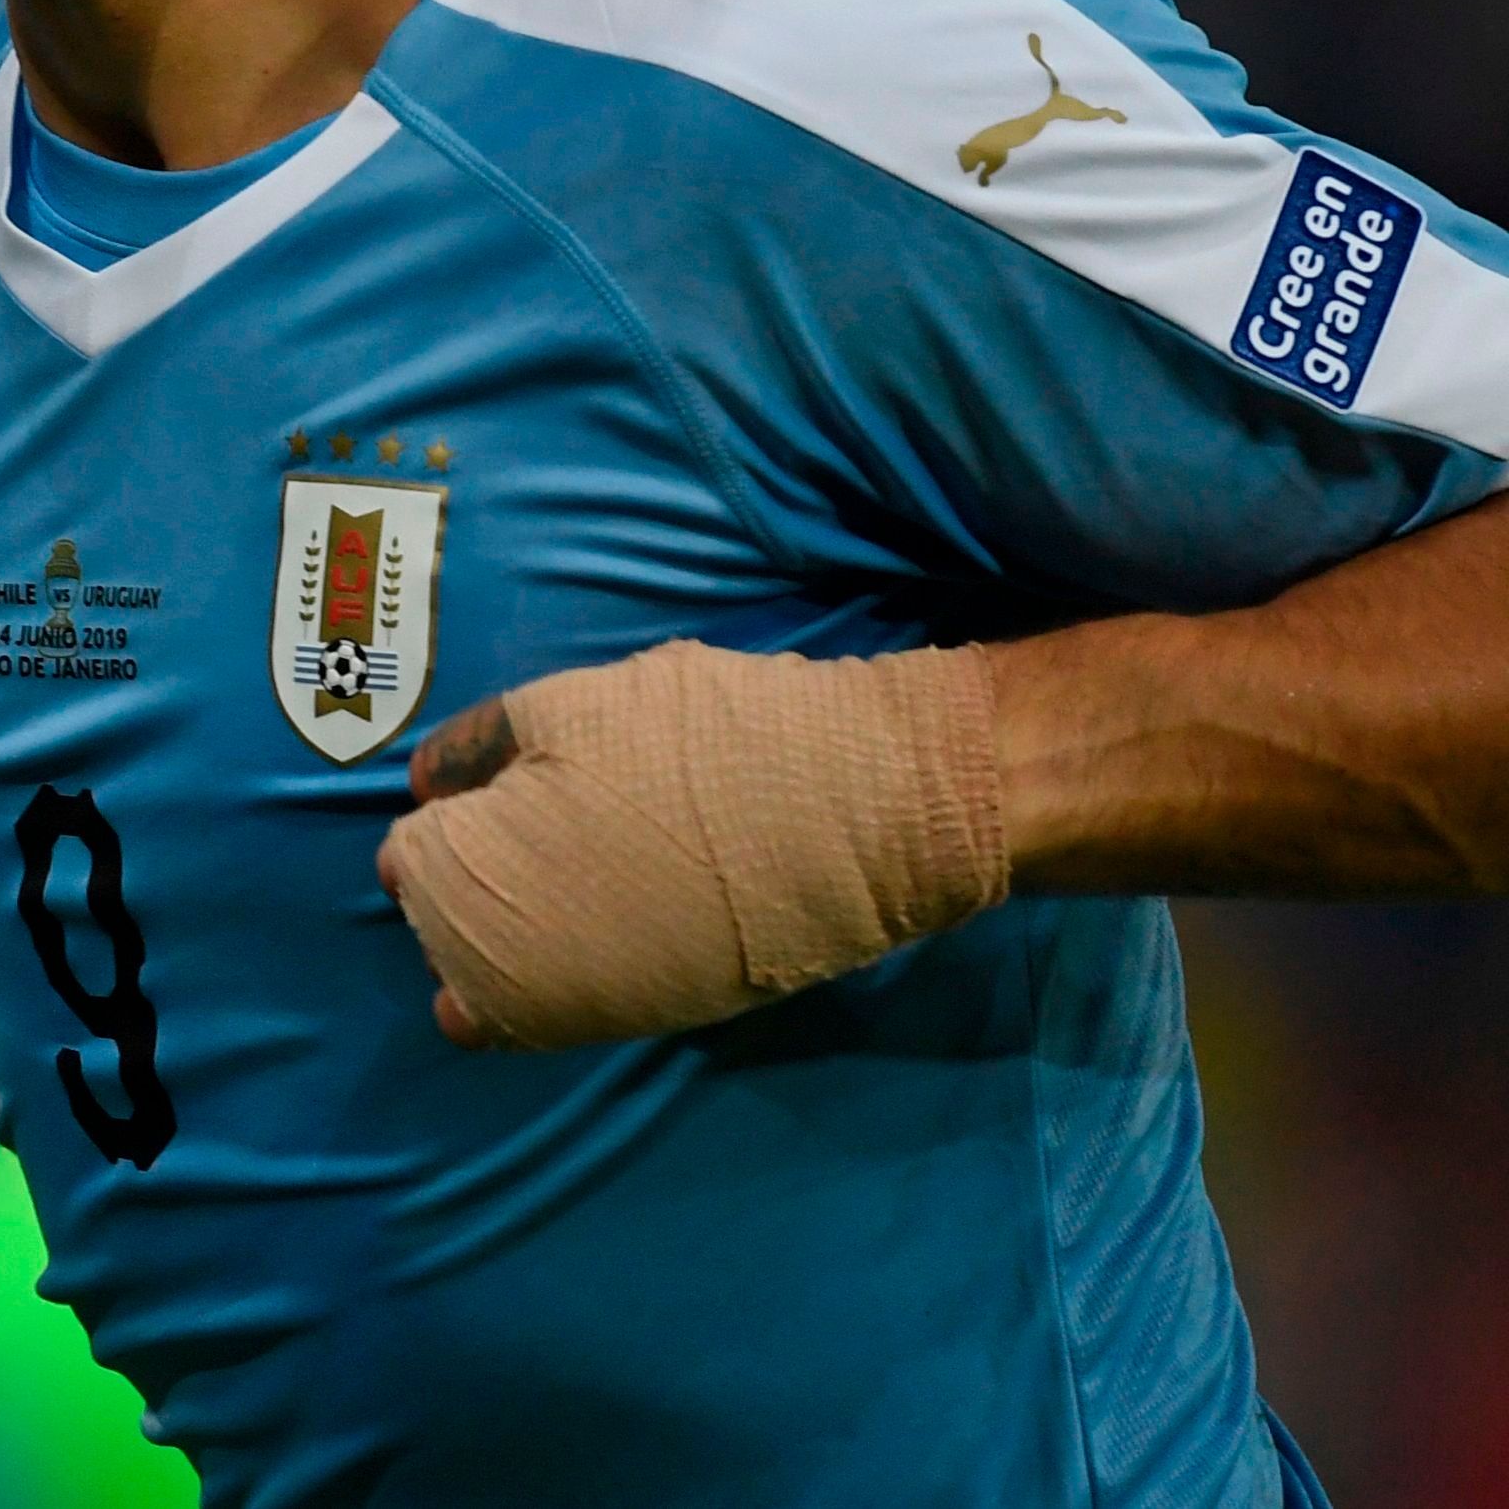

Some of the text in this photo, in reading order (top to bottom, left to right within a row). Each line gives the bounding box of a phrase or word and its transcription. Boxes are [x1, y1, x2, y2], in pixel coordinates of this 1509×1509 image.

[1248, 175, 1352, 360] Cree en
[1303, 209, 1394, 393] grande
[83, 585, 162, 609] URUGUAY
[329, 530, 368, 628] AUF
[15, 625, 77, 649] JUNIO
[83, 627, 127, 650] 2019
[18, 655, 46, 678] DE
[52, 658, 138, 680] JANEIRO
[15, 784, 177, 1171] 9
